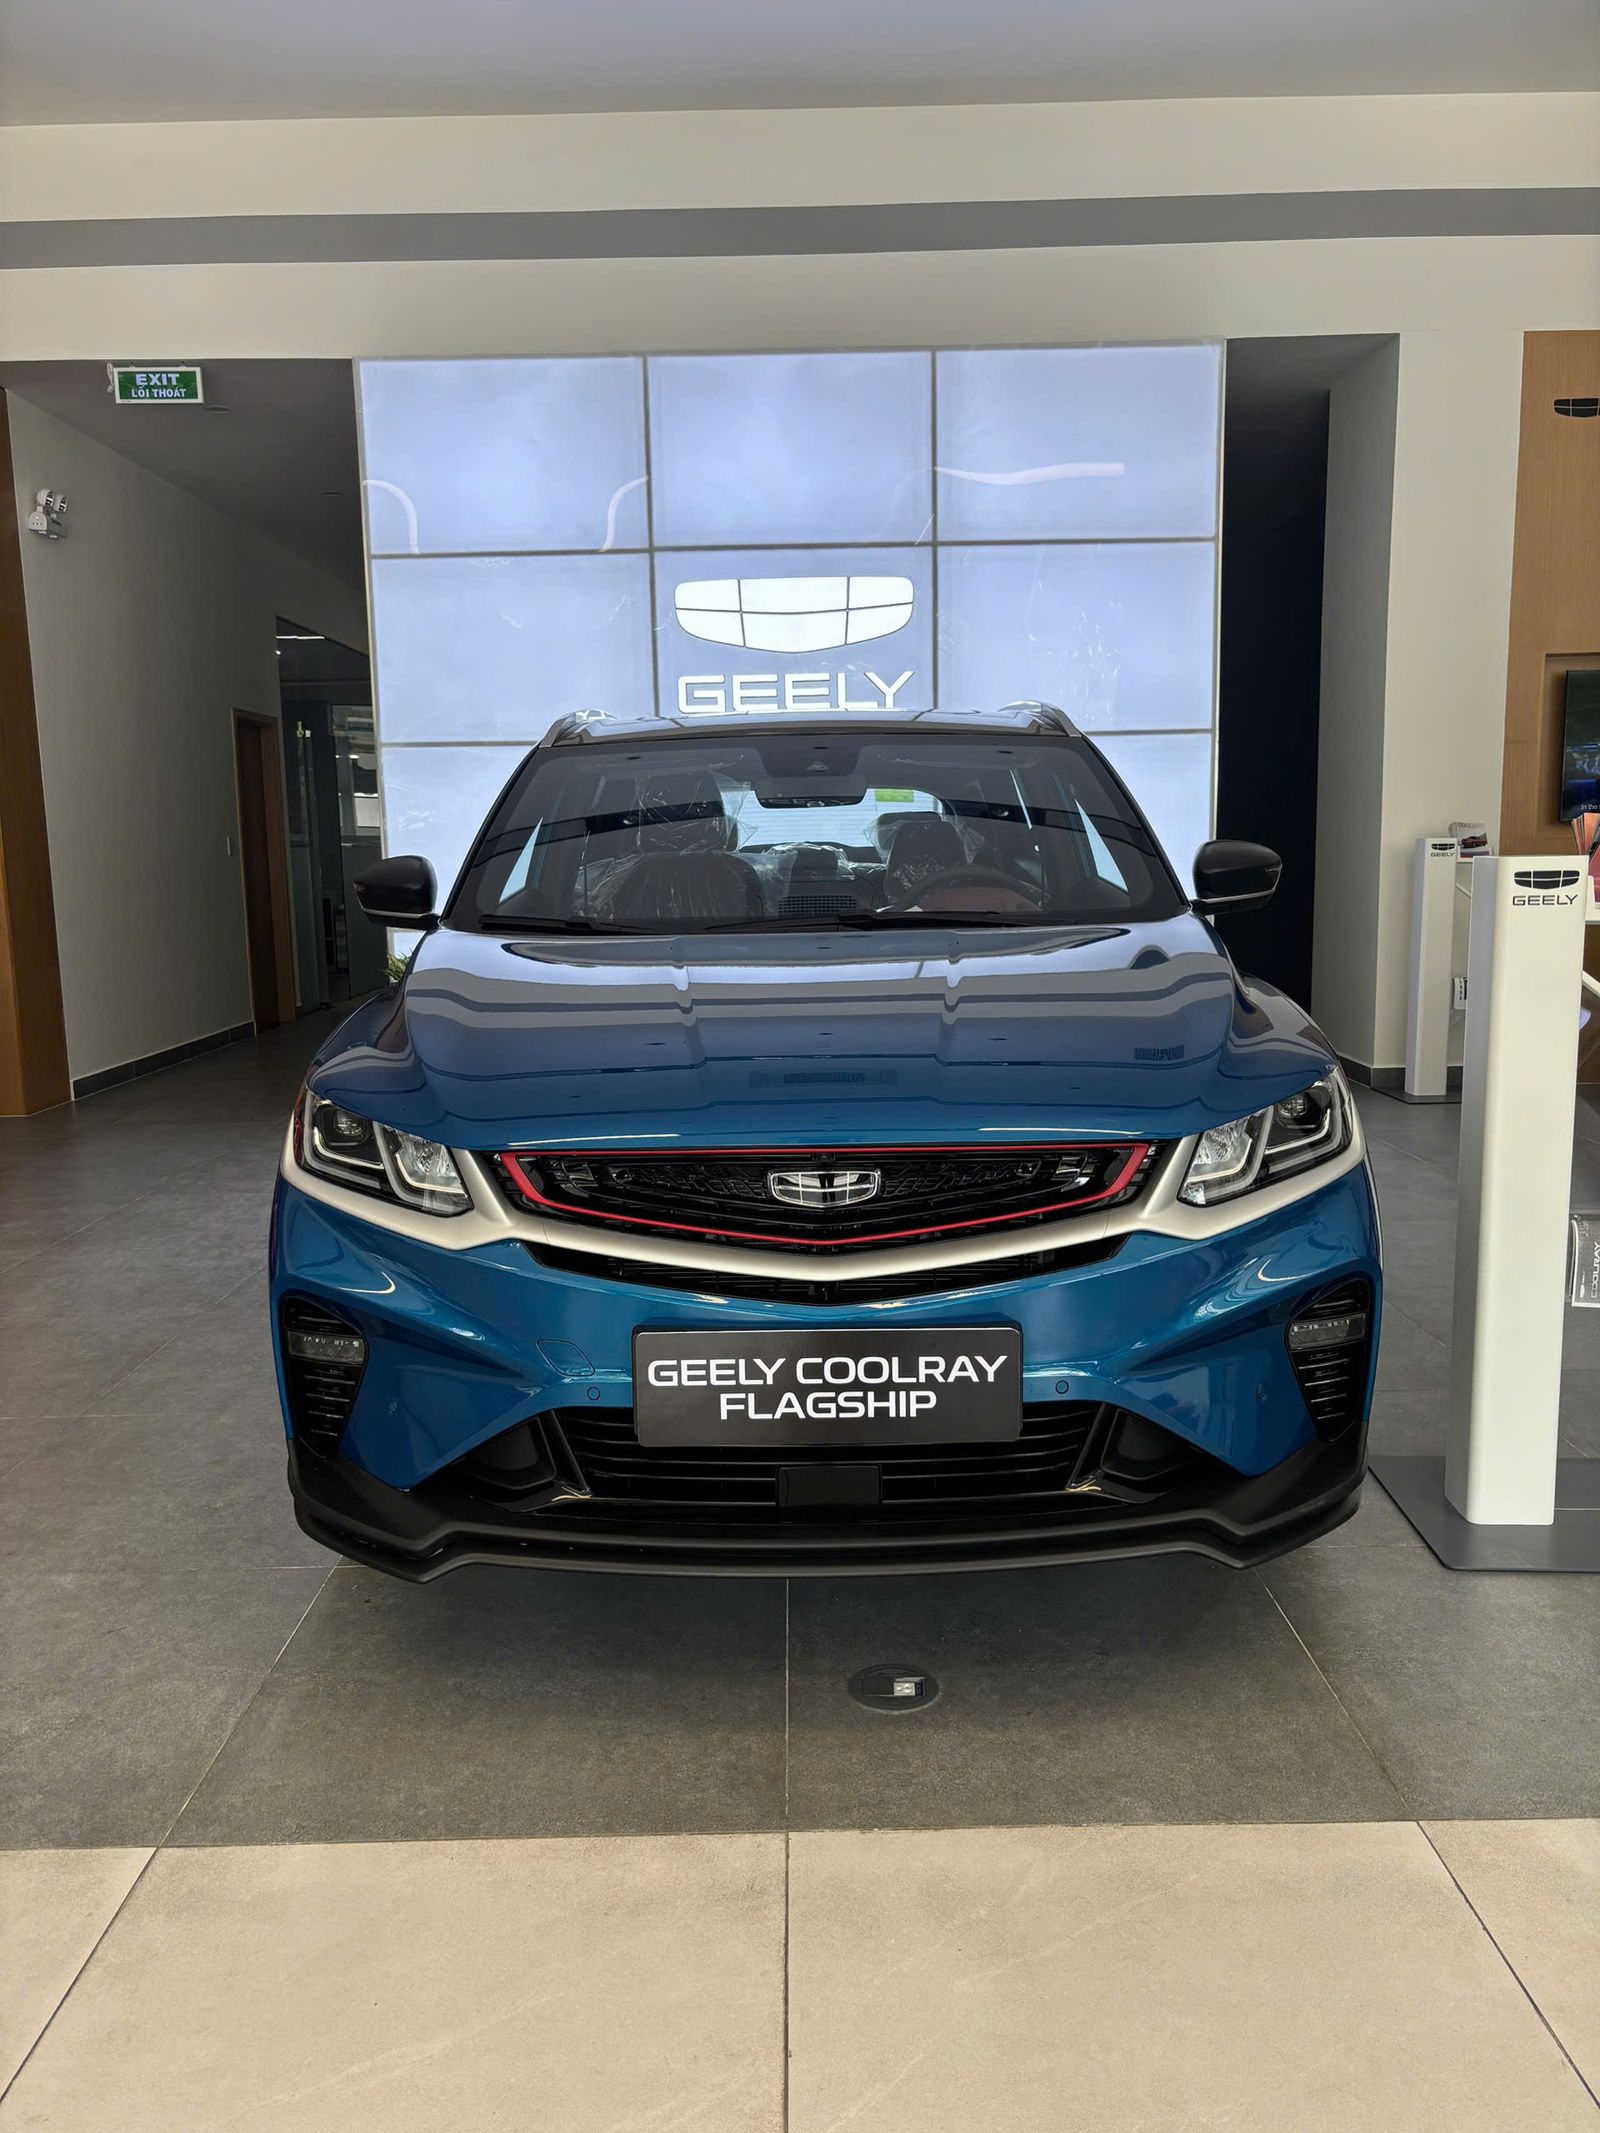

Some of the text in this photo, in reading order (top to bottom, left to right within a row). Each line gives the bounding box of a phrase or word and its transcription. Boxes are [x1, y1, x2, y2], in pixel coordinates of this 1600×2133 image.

[135, 373, 180, 386] EXIT
[152, 387, 187, 398] THOÁT
[677, 671, 914, 714] GEELY
[1512, 894, 1578, 906] GEELY
[647, 1354, 1008, 1387] GEELY COOLRAY
[719, 1390, 938, 1420] FLAGSHIP
